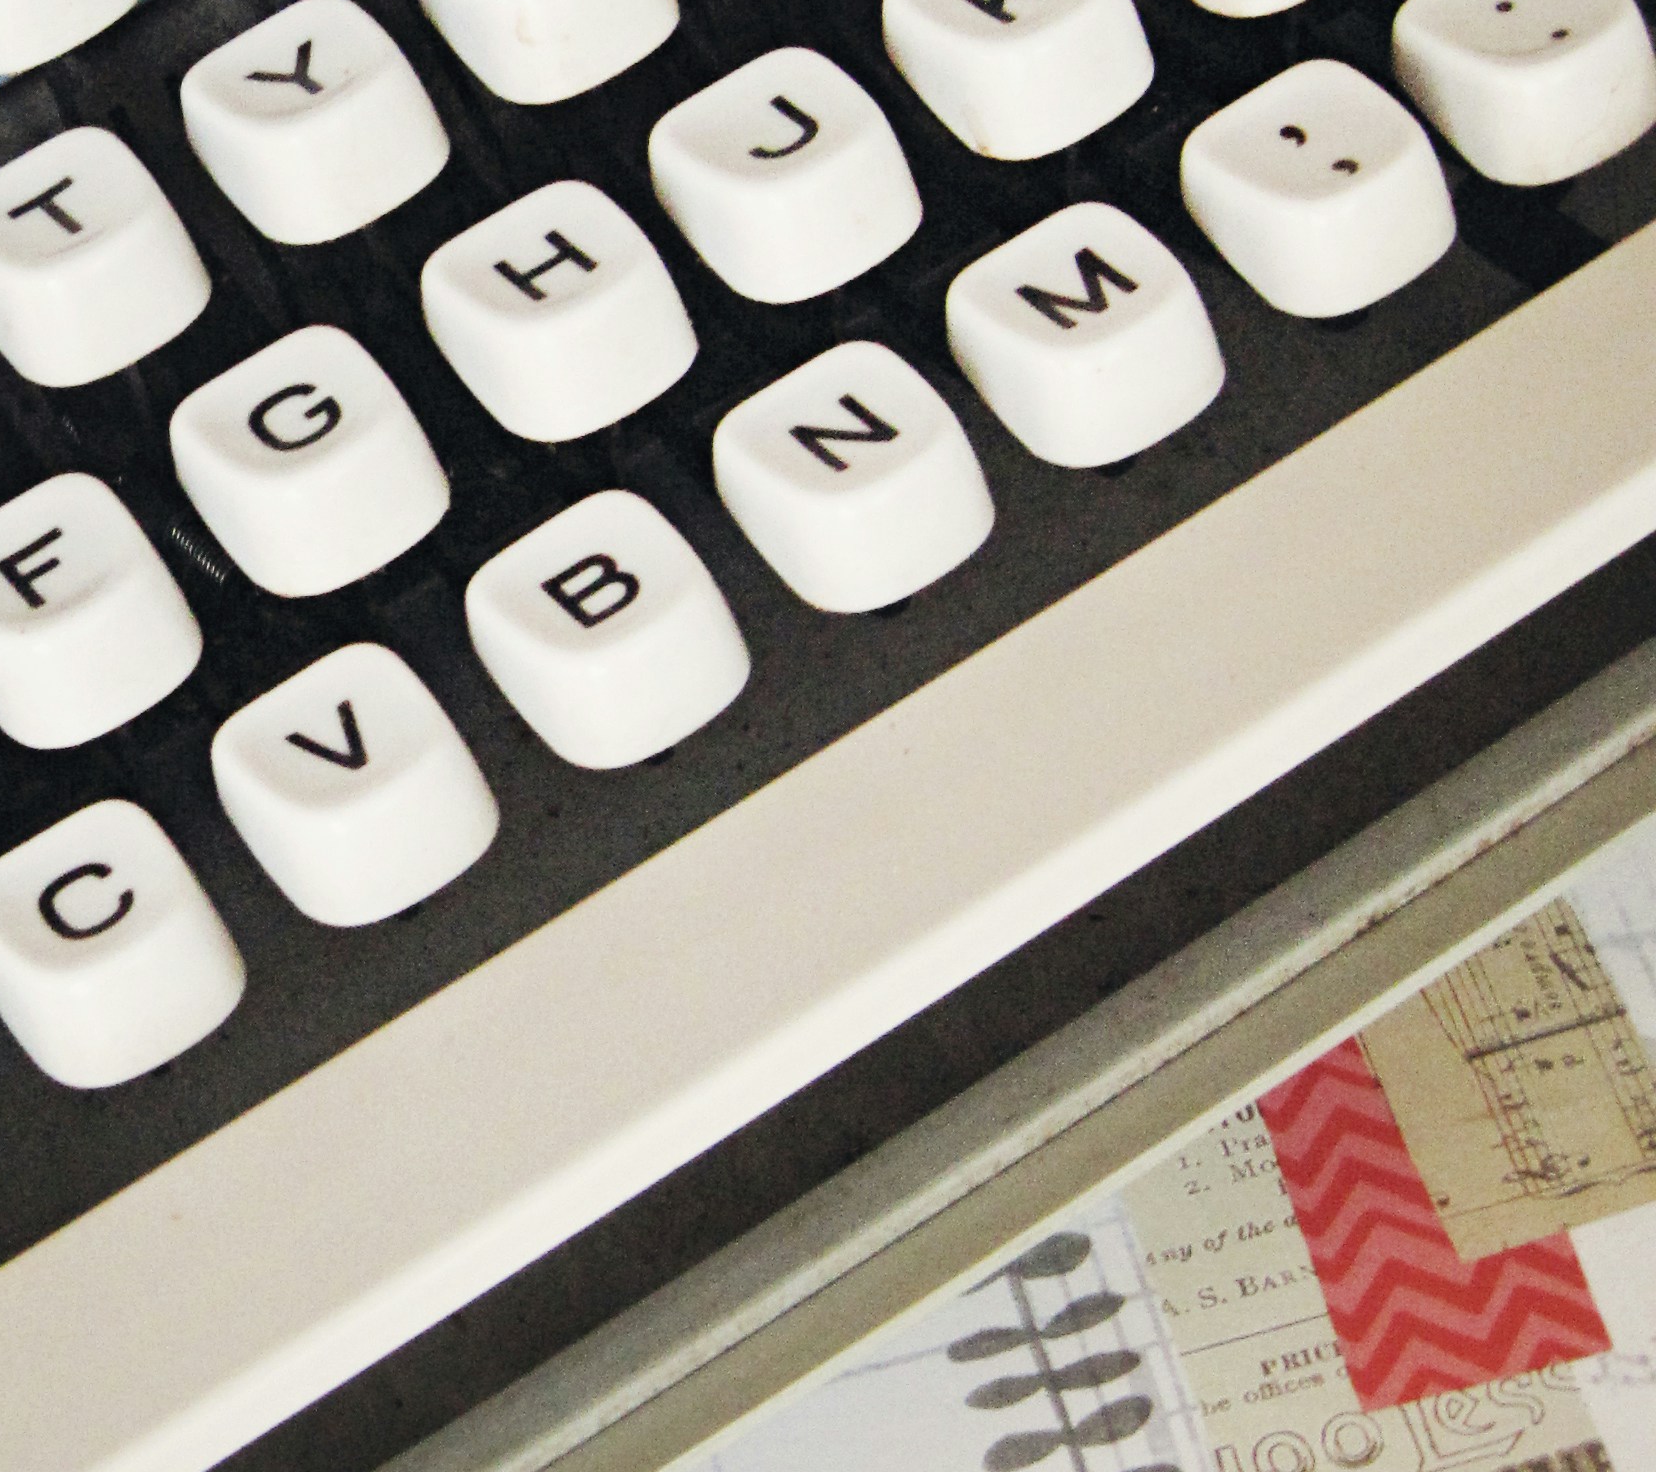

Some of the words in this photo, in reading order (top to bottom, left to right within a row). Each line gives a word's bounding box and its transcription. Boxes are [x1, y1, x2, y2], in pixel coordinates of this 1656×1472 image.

[245, 40, 323, 95] Y
[749, 95, 819, 160] J
[7, 177, 82, 234] T
[493, 230, 598, 301] H
[1015, 247, 1138, 330] M
[247, 383, 342, 452] G
[788, 394, 899, 472] N
[541, 553, 640, 629] B
[285, 700, 368, 770] V
[37, 862, 134, 941] C
